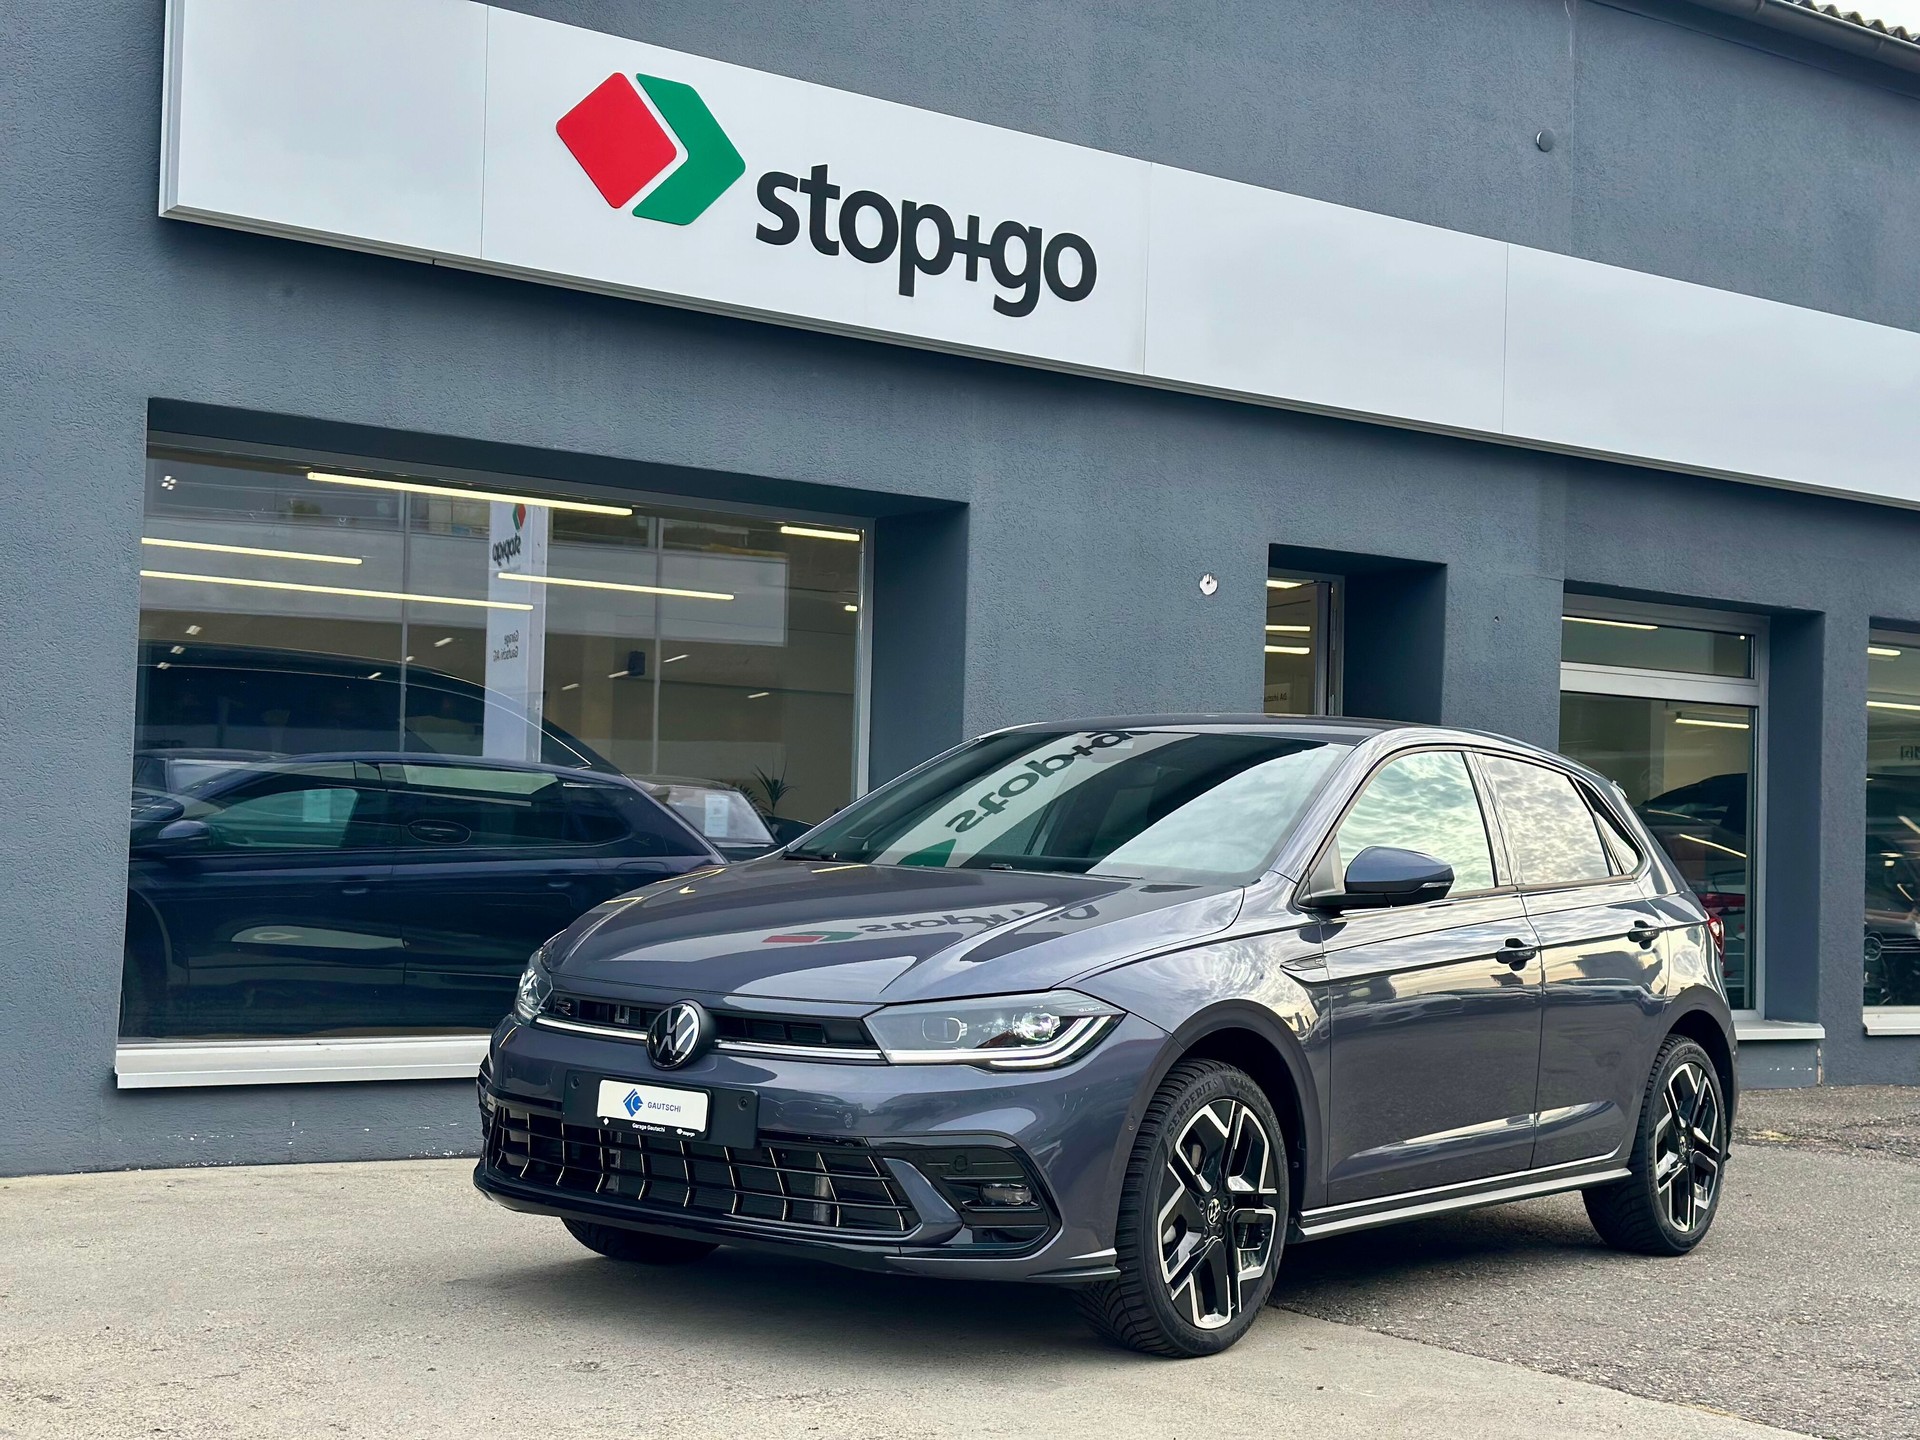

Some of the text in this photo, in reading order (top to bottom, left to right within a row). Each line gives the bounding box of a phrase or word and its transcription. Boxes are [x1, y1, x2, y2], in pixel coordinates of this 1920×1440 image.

[755, 163, 1098, 318] stop+go
[647, 1101, 682, 1113] GAUTSCHI
[1166, 1080, 1214, 1136] SEMPERIT
